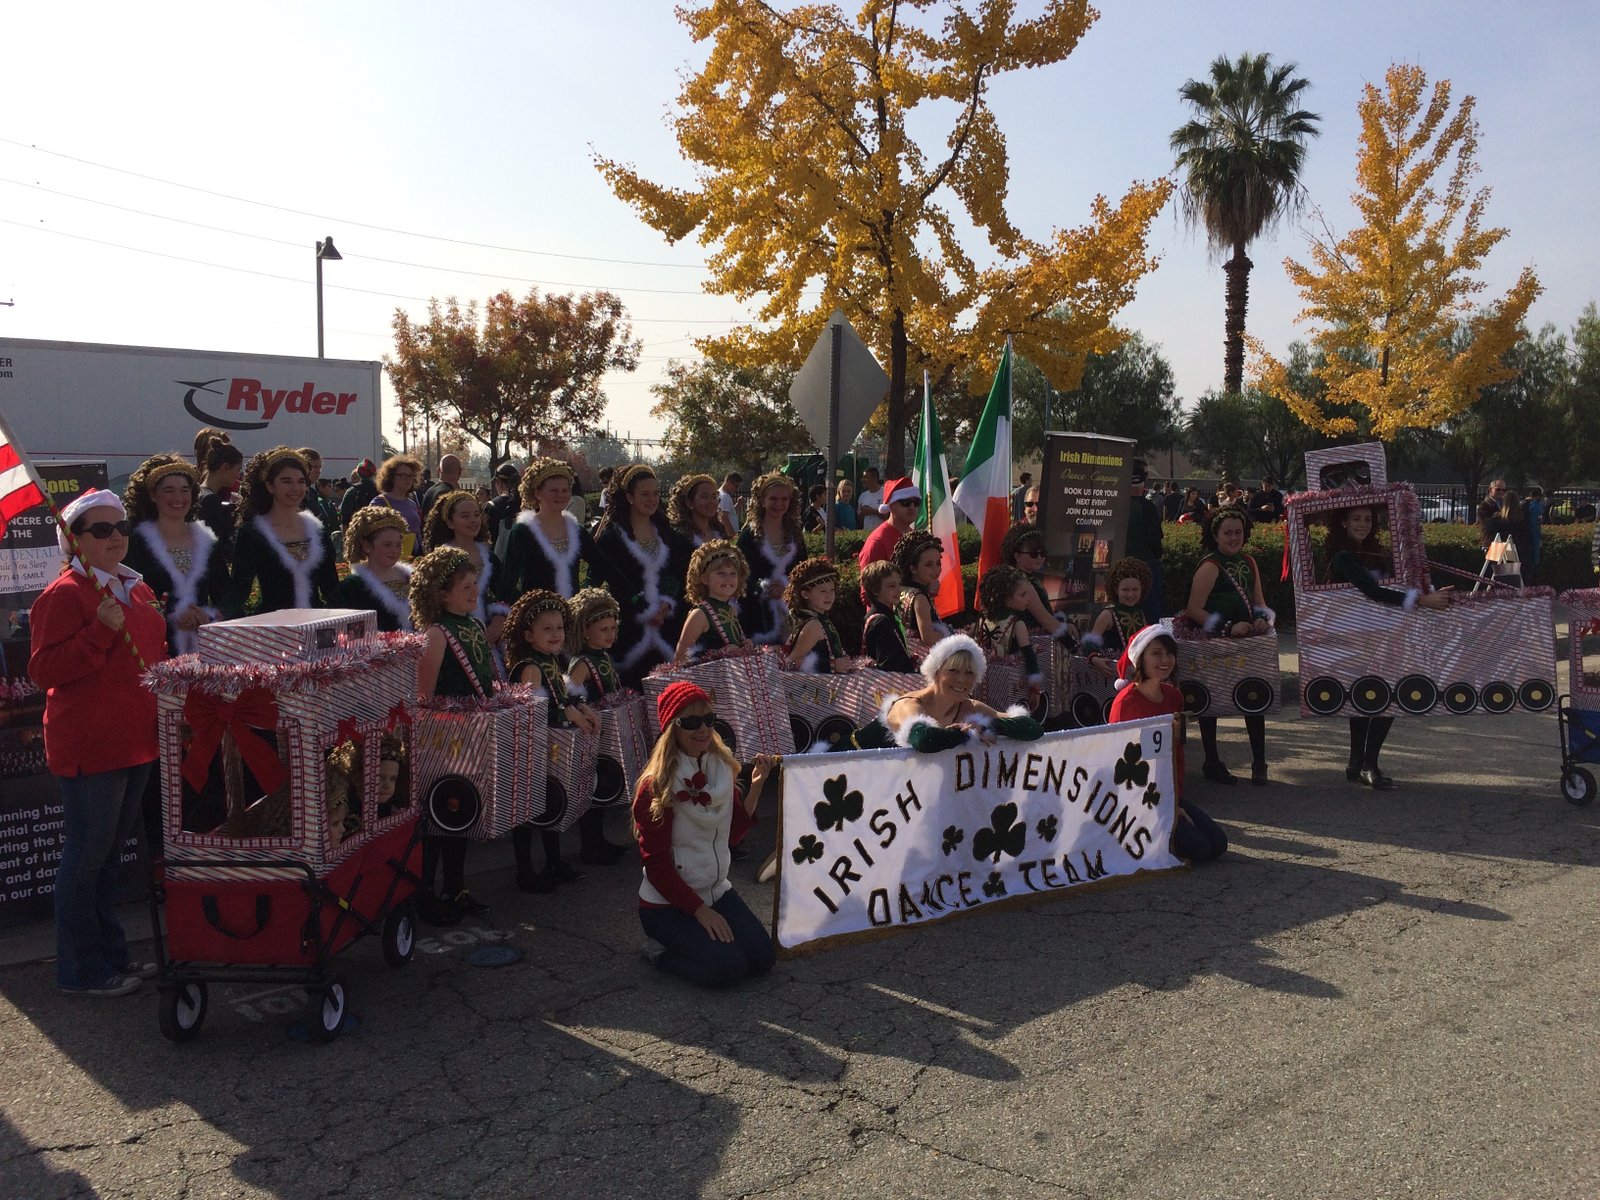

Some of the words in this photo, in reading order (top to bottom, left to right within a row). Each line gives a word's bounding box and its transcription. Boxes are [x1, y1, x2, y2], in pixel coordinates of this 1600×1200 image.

[226, 378, 357, 420] Ryder
[1059, 450, 1080, 463] Irish
[1081, 452, 1124, 467] Dimensions
[1063, 487, 1082, 495] BOOK
[1083, 488, 1092, 496] US
[1092, 489, 1103, 497] FOR
[1075, 498, 1091, 506] NEXT
[1091, 499, 1107, 507] EVENT
[1082, 508, 1095, 516] OUR
[1095, 509, 1113, 517] DANCE
[1075, 518, 1104, 526] COMPANY
[11, 529, 33, 539] THE
[29, 560, 48, 569] Sleep
[1153, 730, 1163, 754] 9
[813, 779, 922, 914] IRISH
[955, 751, 1153, 860] DIMENSIONS
[33, 836, 55, 848] the
[25, 853, 39, 865] of
[5, 869, 31, 885] and
[10, 887, 33, 900] our
[868, 871, 980, 926] DANCE
[1018, 850, 1109, 891] TEAM
